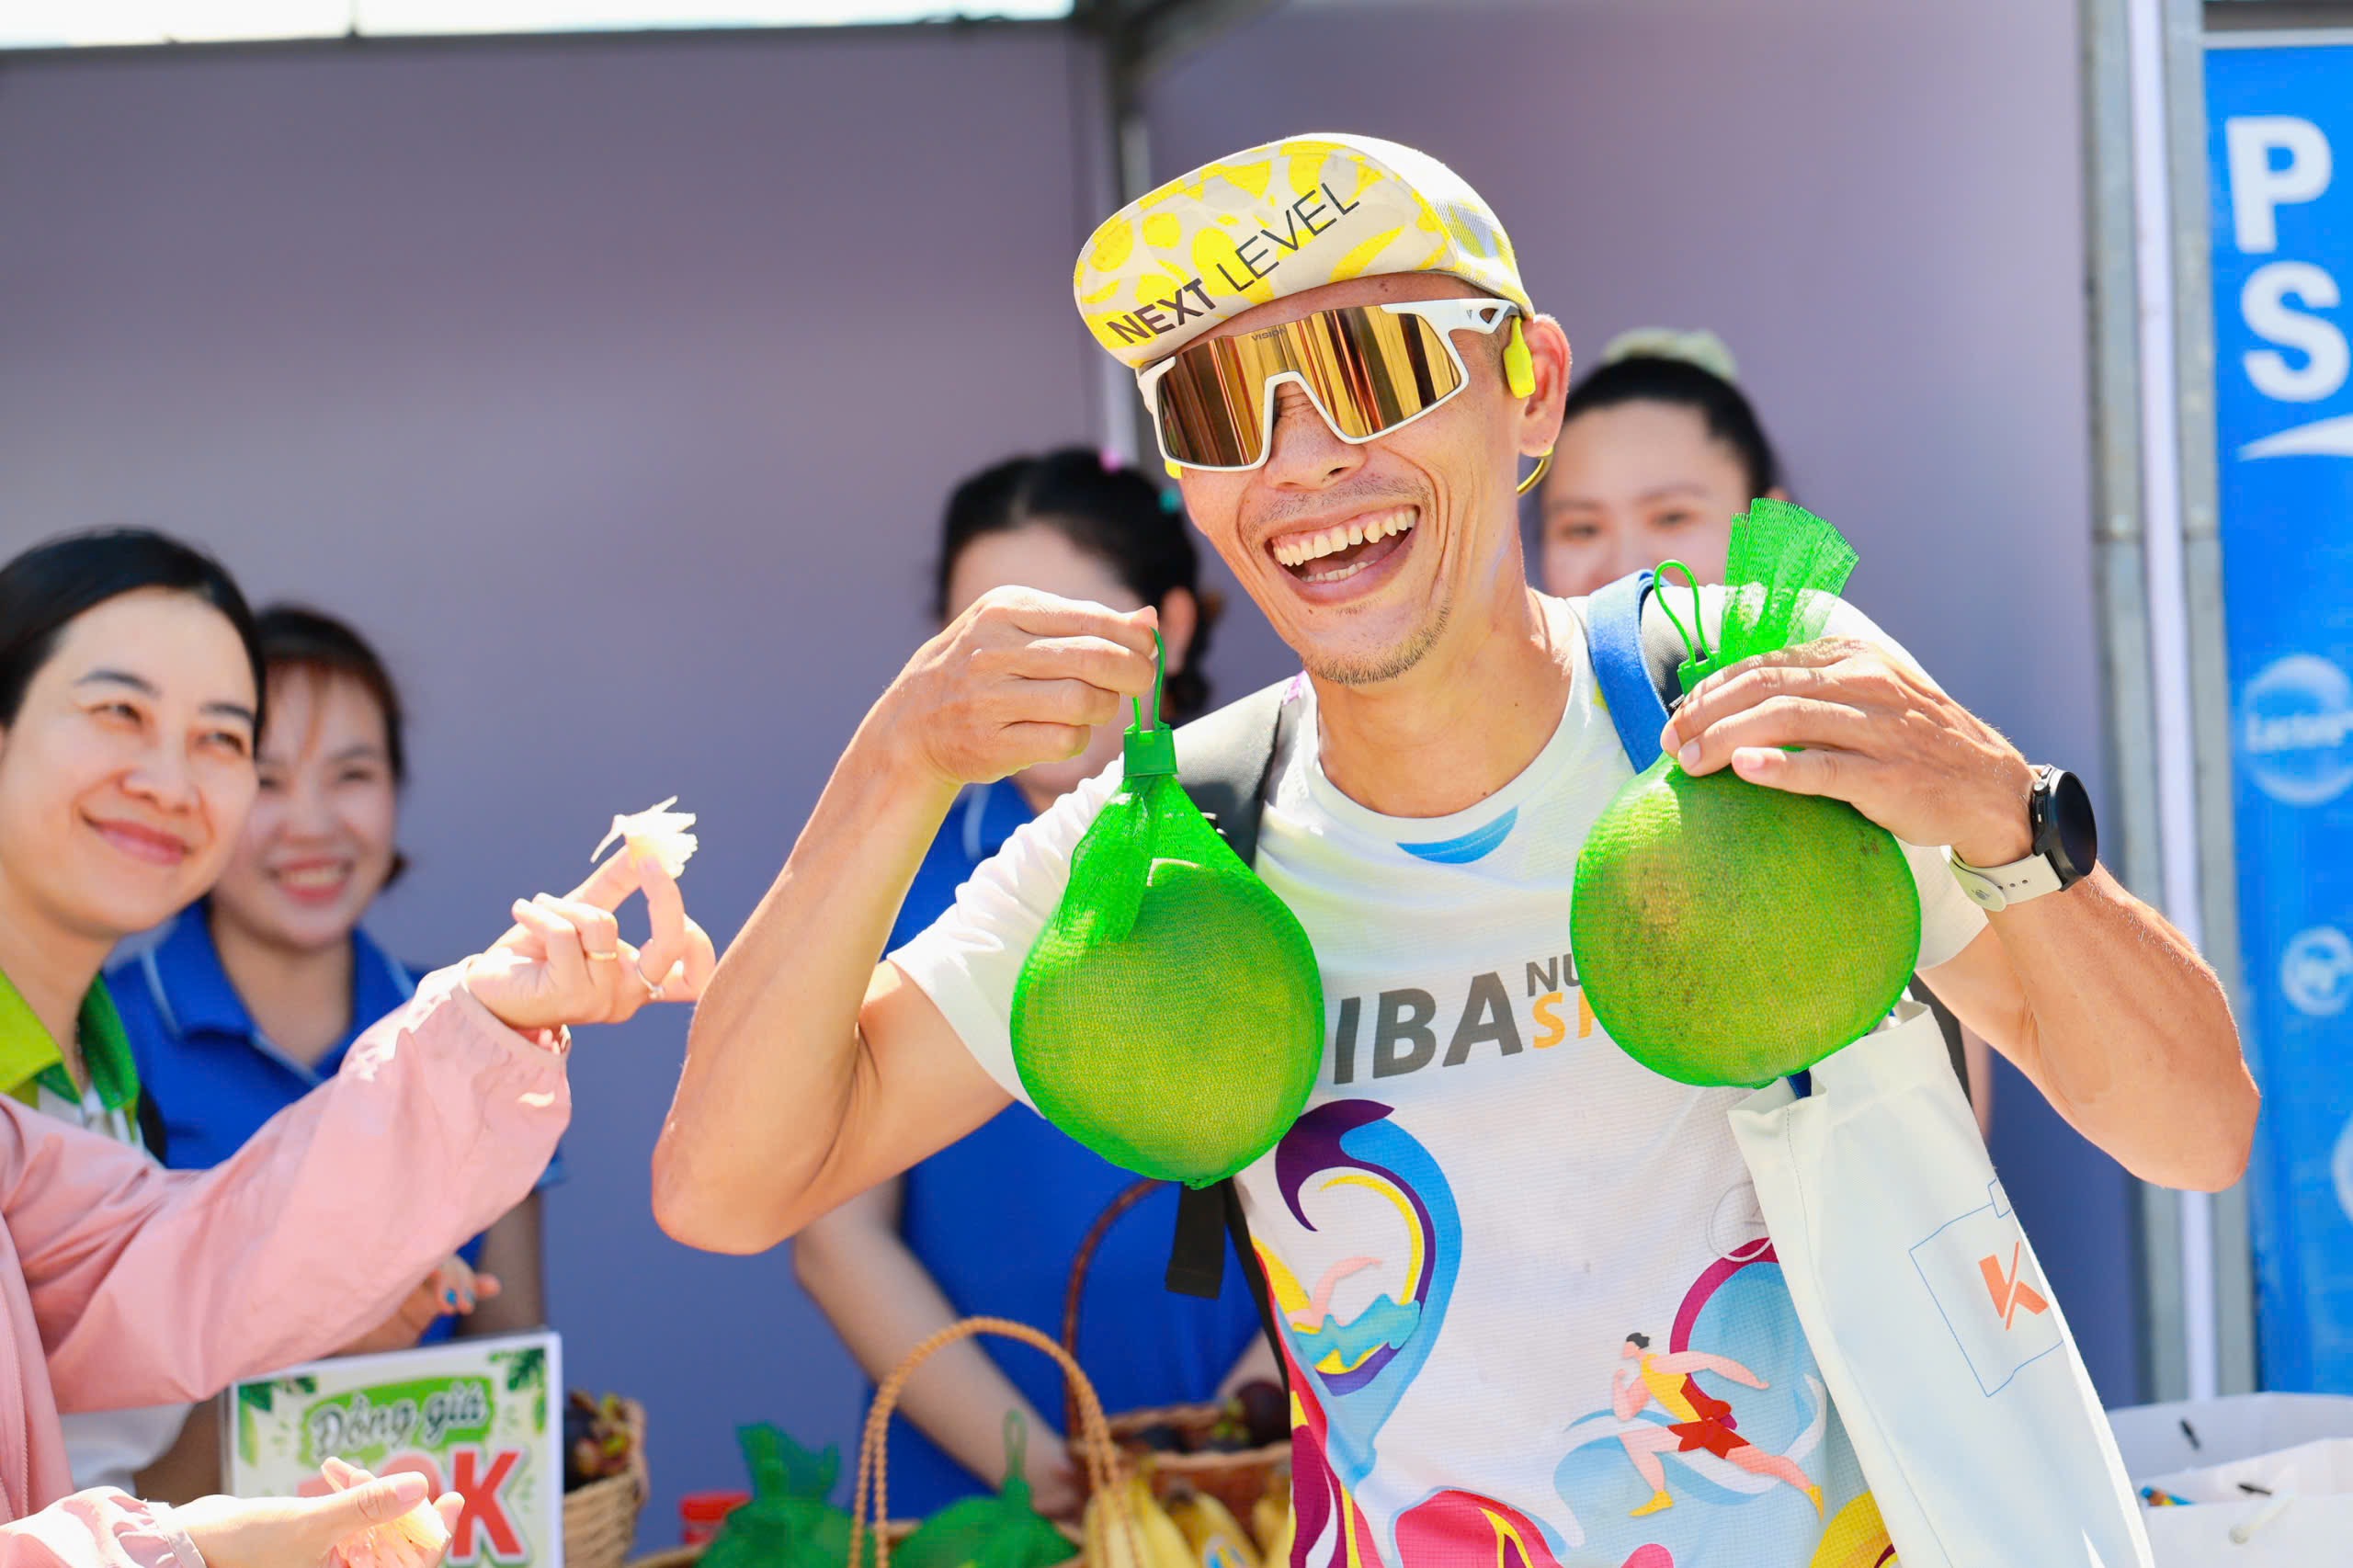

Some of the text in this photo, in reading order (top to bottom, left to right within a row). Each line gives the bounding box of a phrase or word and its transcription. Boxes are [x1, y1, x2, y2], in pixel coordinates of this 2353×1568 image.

[1107, 182, 1360, 345] NEXT LEVEL
[1334, 971, 1523, 1085] IBA
